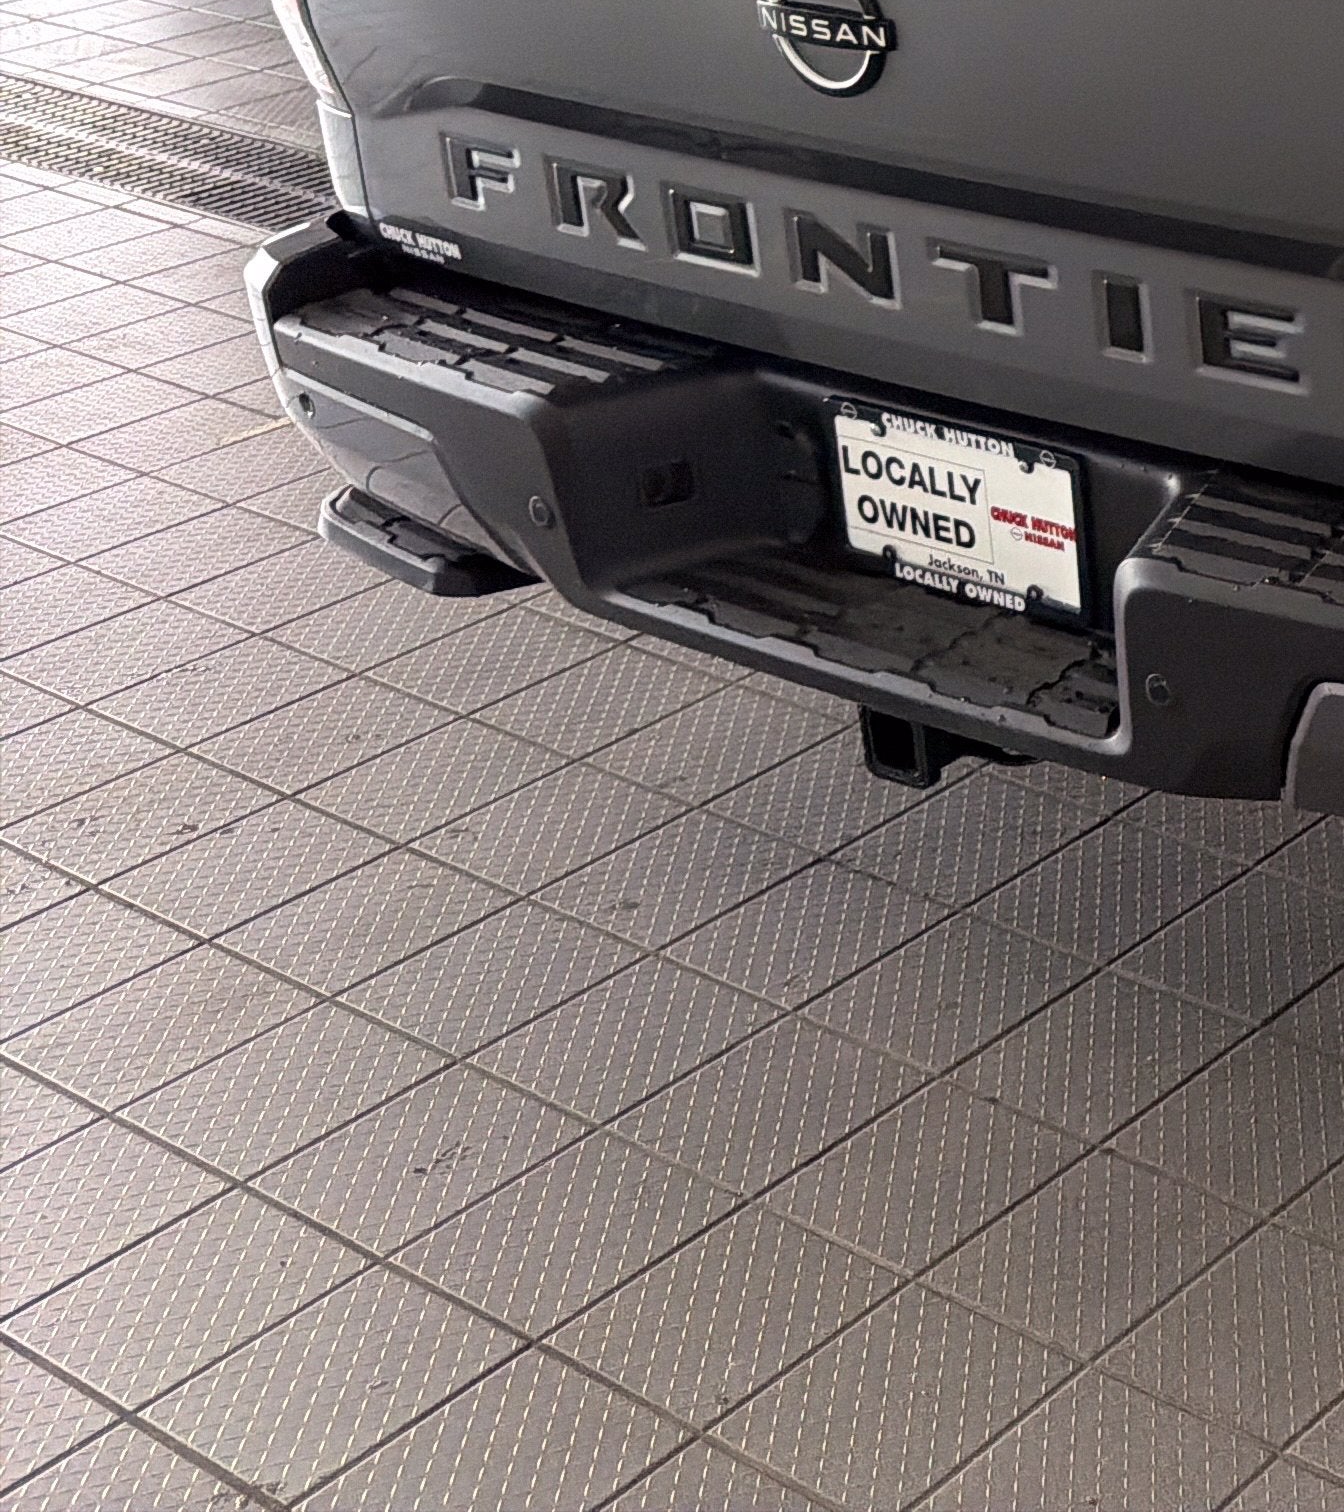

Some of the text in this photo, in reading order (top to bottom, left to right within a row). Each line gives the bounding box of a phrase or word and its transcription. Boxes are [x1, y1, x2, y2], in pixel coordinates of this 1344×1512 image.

[760, 6, 887, 48] NISSAN
[881, 412, 1016, 458] CHUCK HUTTON
[841, 444, 982, 506] LOCALLY
[857, 494, 976, 550] OWNED
[990, 505, 1029, 529] CHUCK
[1023, 530, 1065, 553] NISSAN
[895, 562, 1026, 613] LOCALLY OWNED
[927, 553, 1006, 586] Jackson, TN
